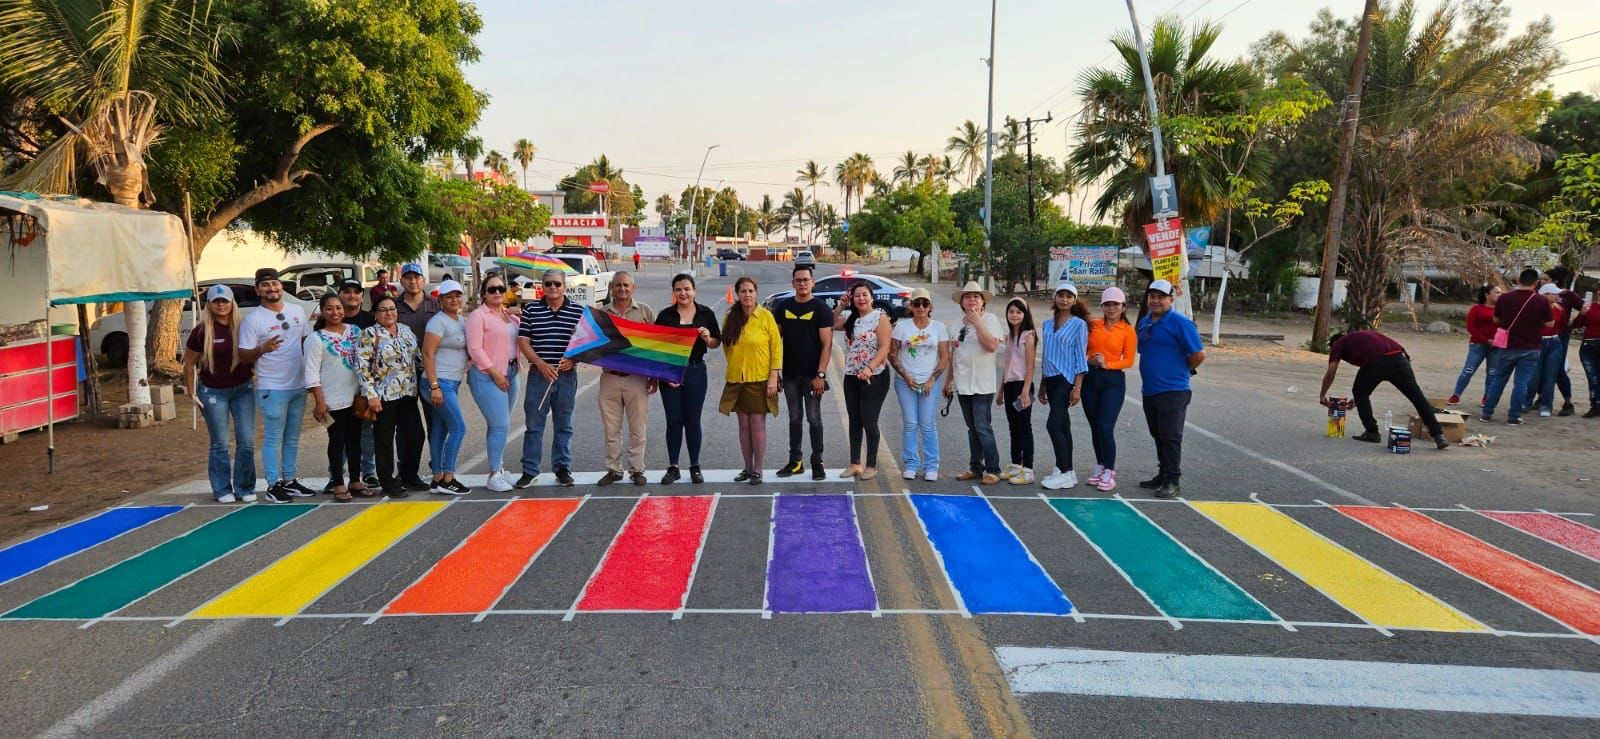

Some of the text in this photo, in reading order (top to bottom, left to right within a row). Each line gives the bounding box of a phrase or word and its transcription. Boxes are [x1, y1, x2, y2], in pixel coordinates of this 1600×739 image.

[1157, 220, 1171, 231] SE
[1149, 229, 1181, 243] VENDE
[1073, 267, 1114, 275] San Rafael
